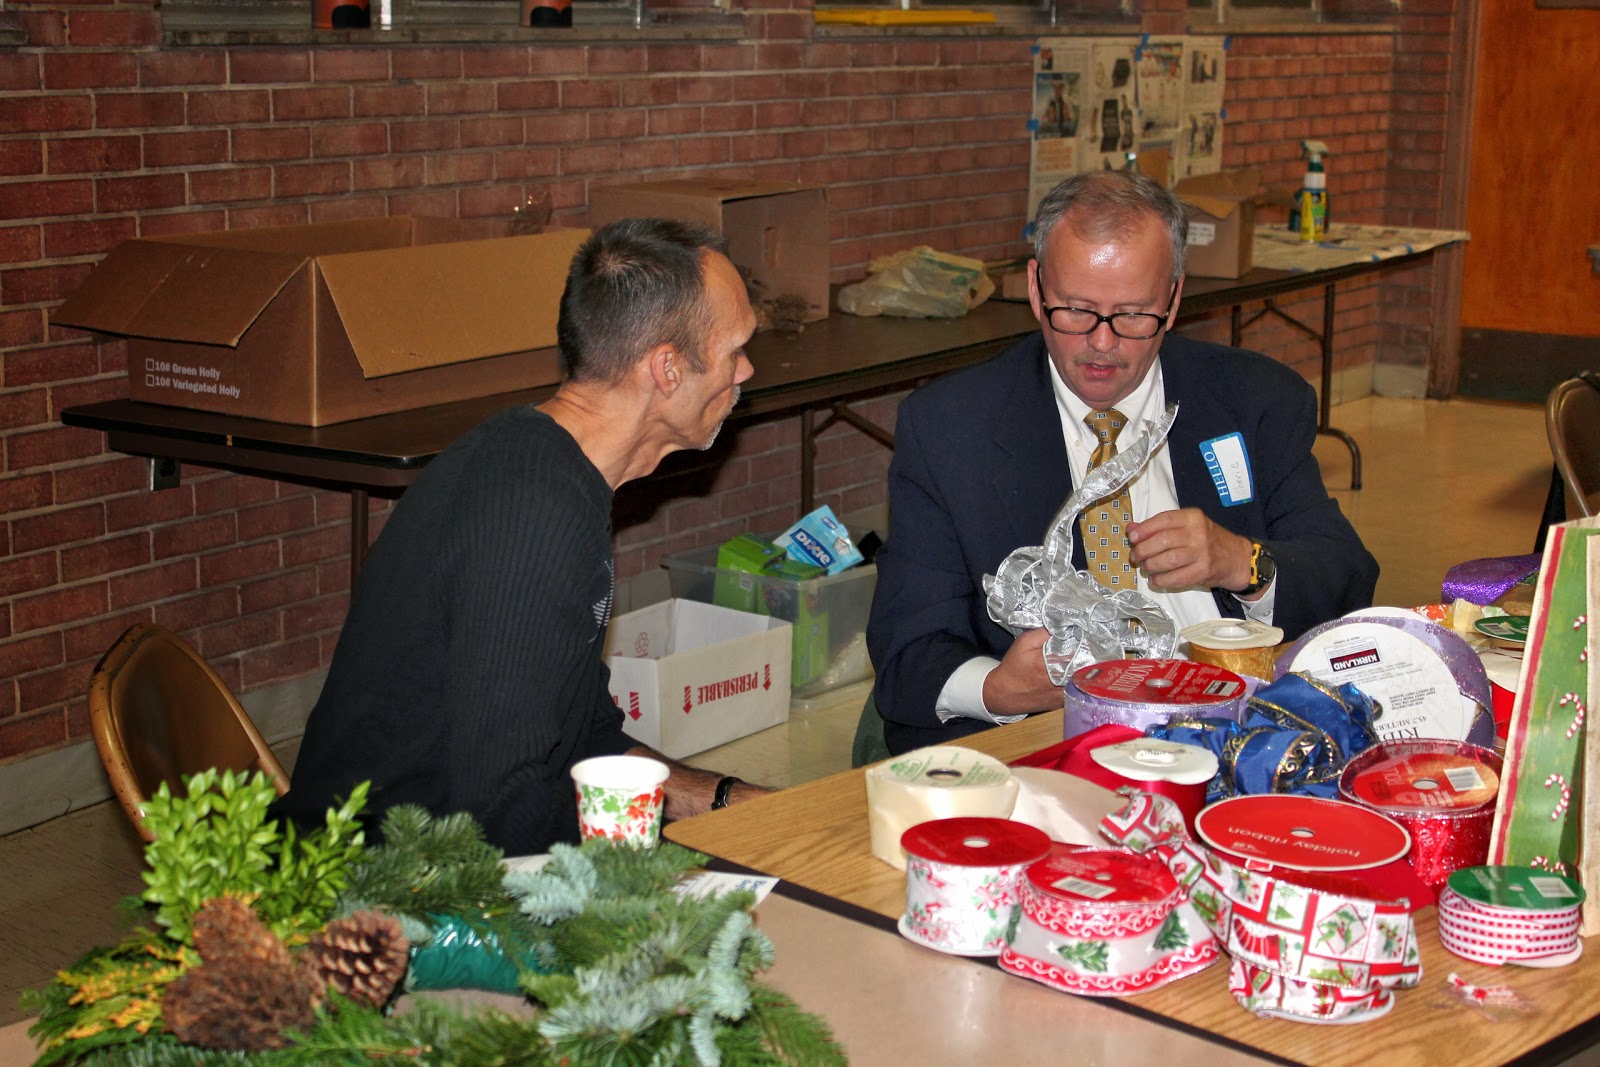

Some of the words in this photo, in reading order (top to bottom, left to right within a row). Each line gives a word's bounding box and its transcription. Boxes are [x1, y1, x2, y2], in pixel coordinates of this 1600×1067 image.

[155, 361, 170, 371] 10#
[172, 363, 197, 376] Green
[199, 367, 221, 381] Holly
[155, 377, 170, 387] 10#
[172, 378, 217, 394] Variegated
[219, 385, 241, 399] Holly
[1203, 451, 1229, 496] HELLO
[1333, 654, 1377, 670] KIRKLAND
[697, 671, 758, 705] PERISHABLE
[1107, 663, 1155, 693] RIBBON
[1228, 826, 1288, 845] ribbon
[1295, 839, 1360, 858] holiday
